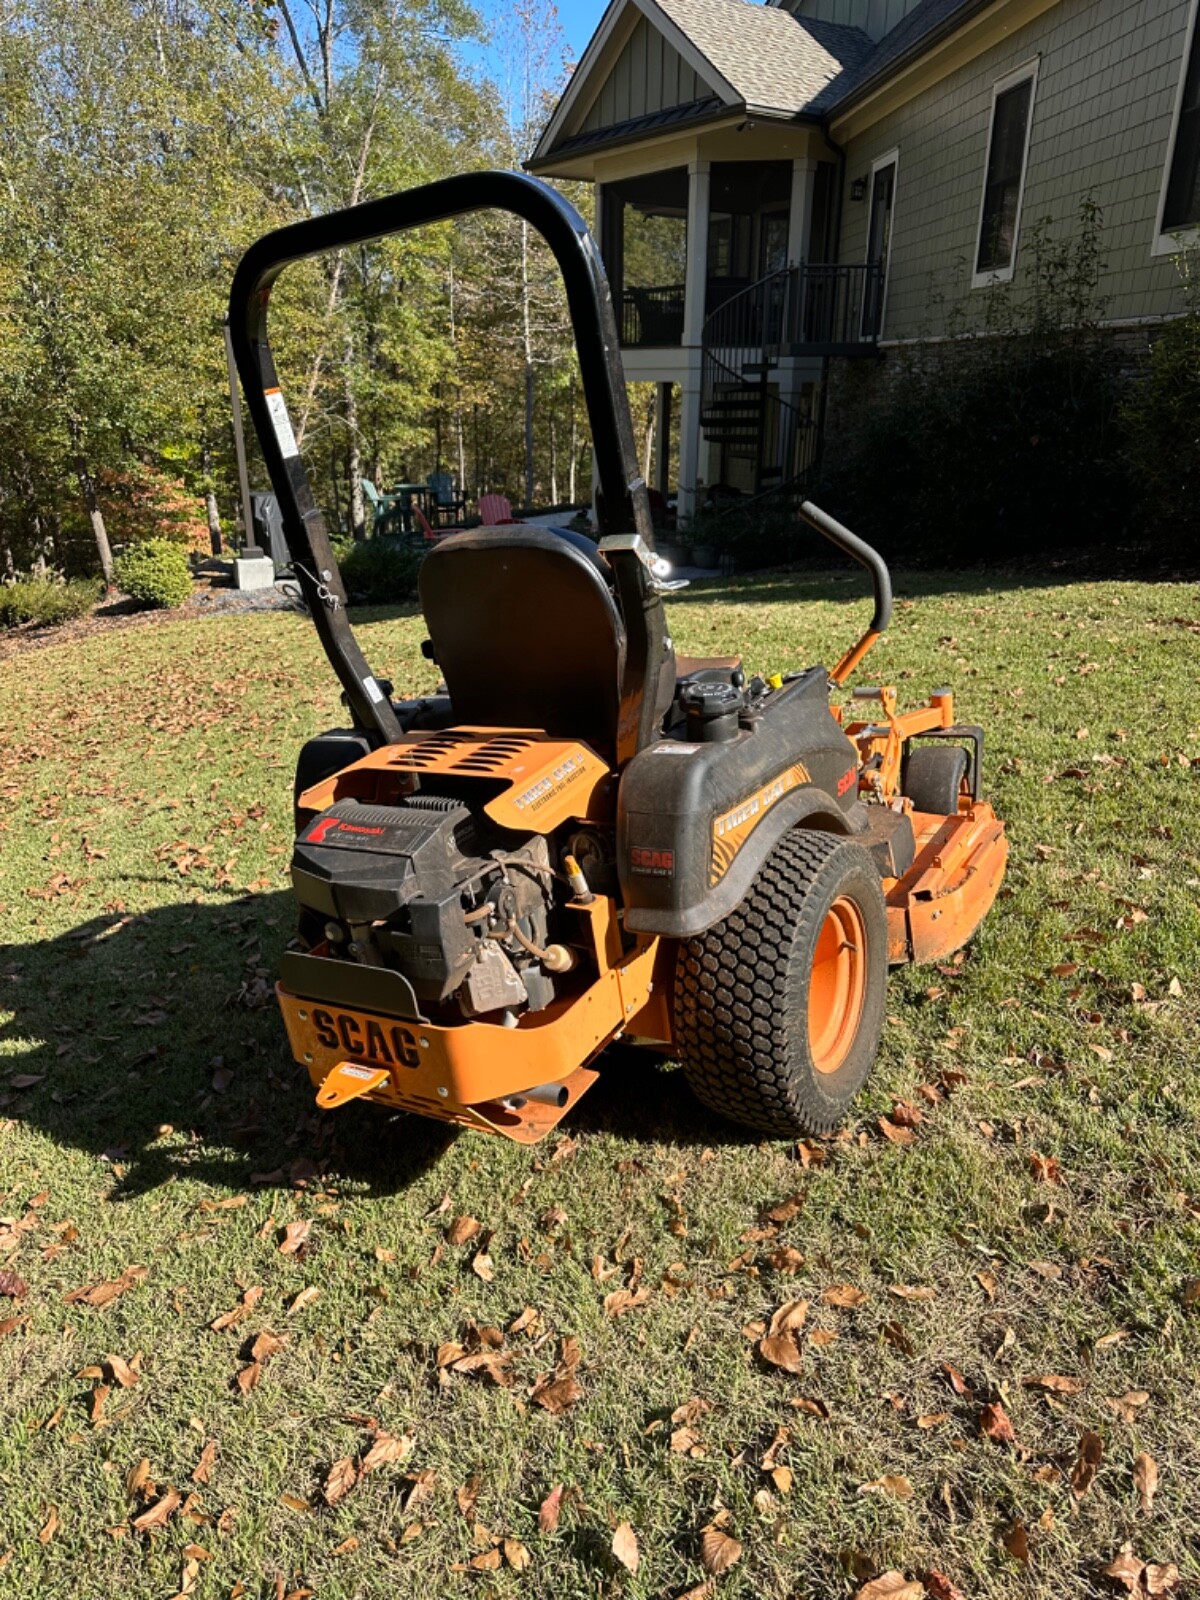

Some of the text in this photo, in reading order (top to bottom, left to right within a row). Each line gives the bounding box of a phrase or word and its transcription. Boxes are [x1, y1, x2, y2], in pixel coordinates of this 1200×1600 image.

[716, 798, 760, 836] TIGER
[763, 779, 785, 805] CAT
[338, 822, 385, 835] Kawasaki
[631, 848, 673, 869] SCAG
[311, 1008, 422, 1069] SCAG
